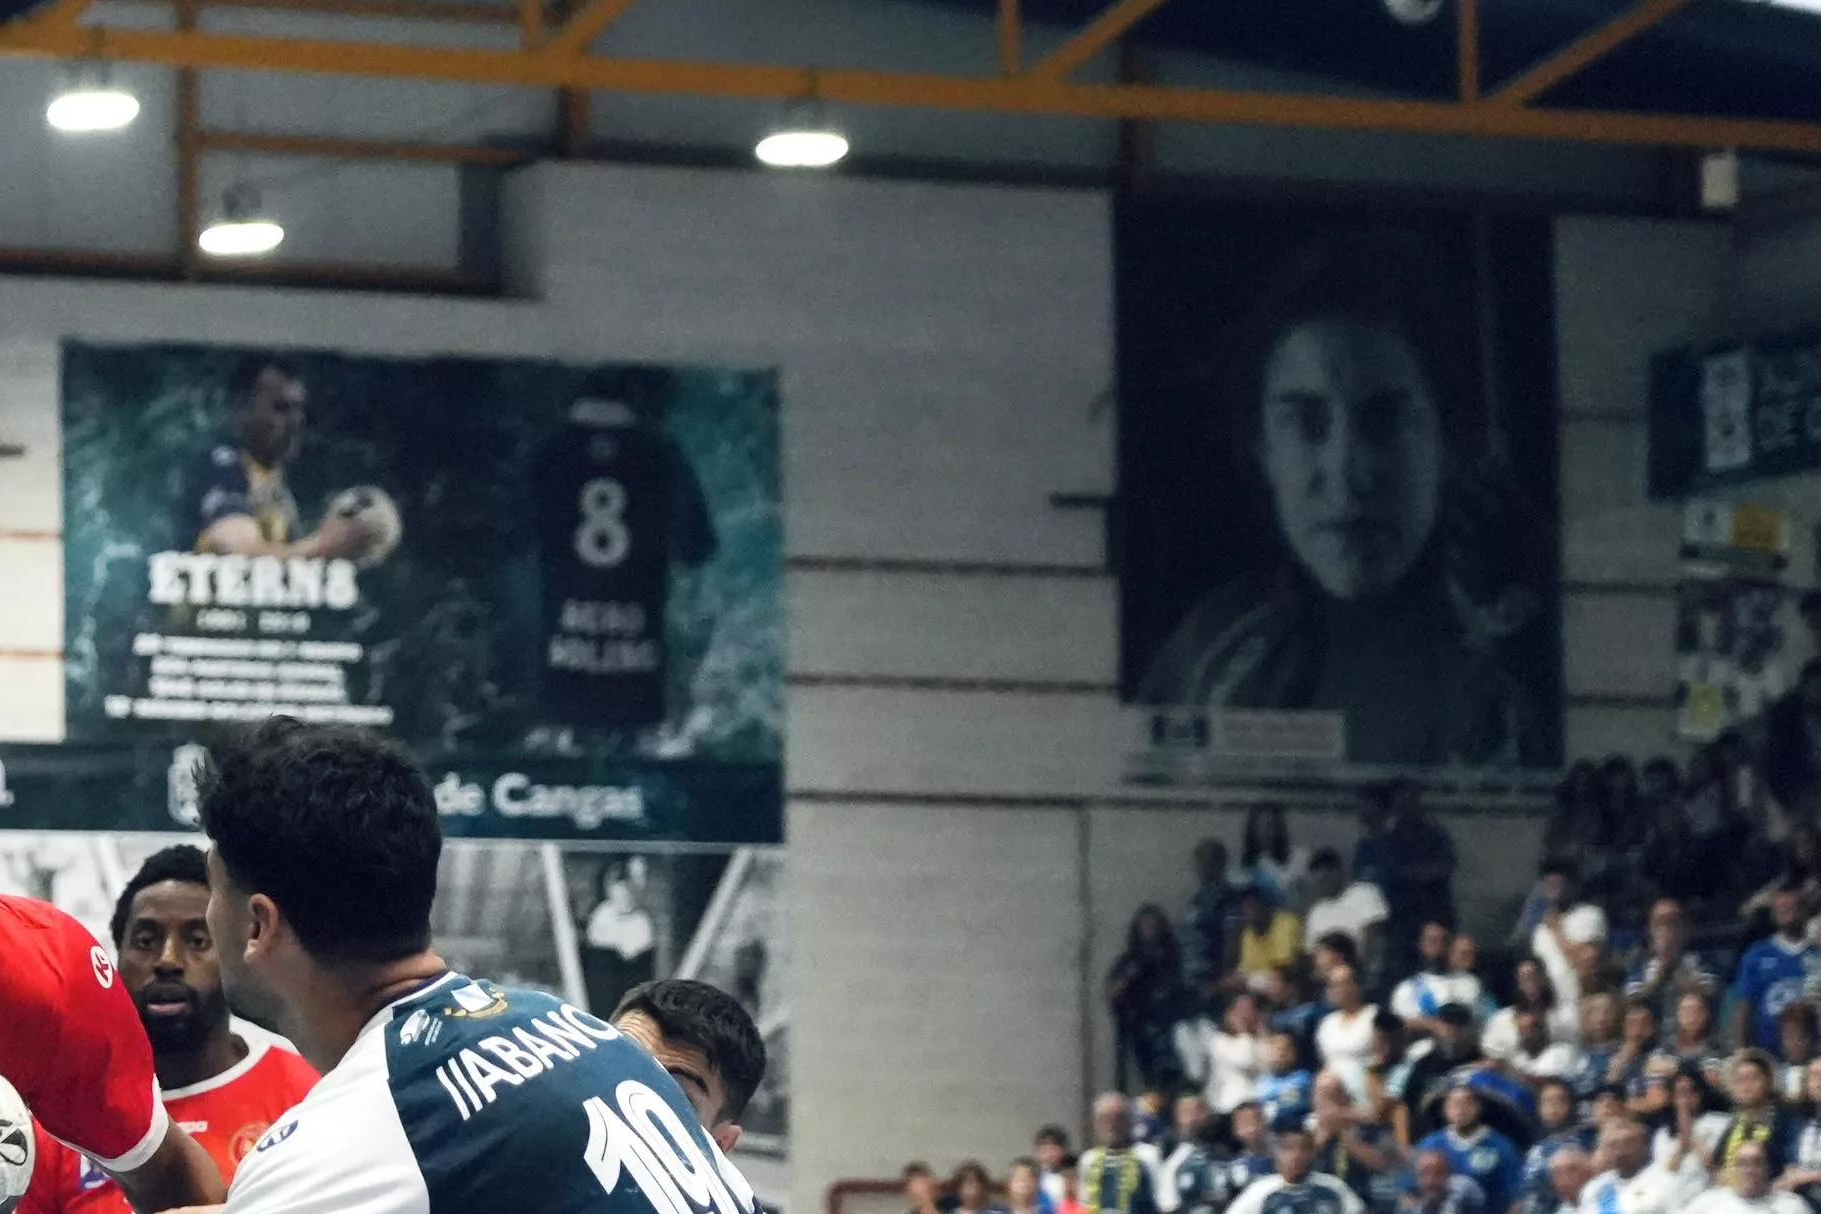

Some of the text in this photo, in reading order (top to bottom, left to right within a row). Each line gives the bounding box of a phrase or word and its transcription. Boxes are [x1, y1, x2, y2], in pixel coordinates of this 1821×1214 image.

[574, 477, 631, 567] 8
[434, 772, 644, 830] de Cangas
